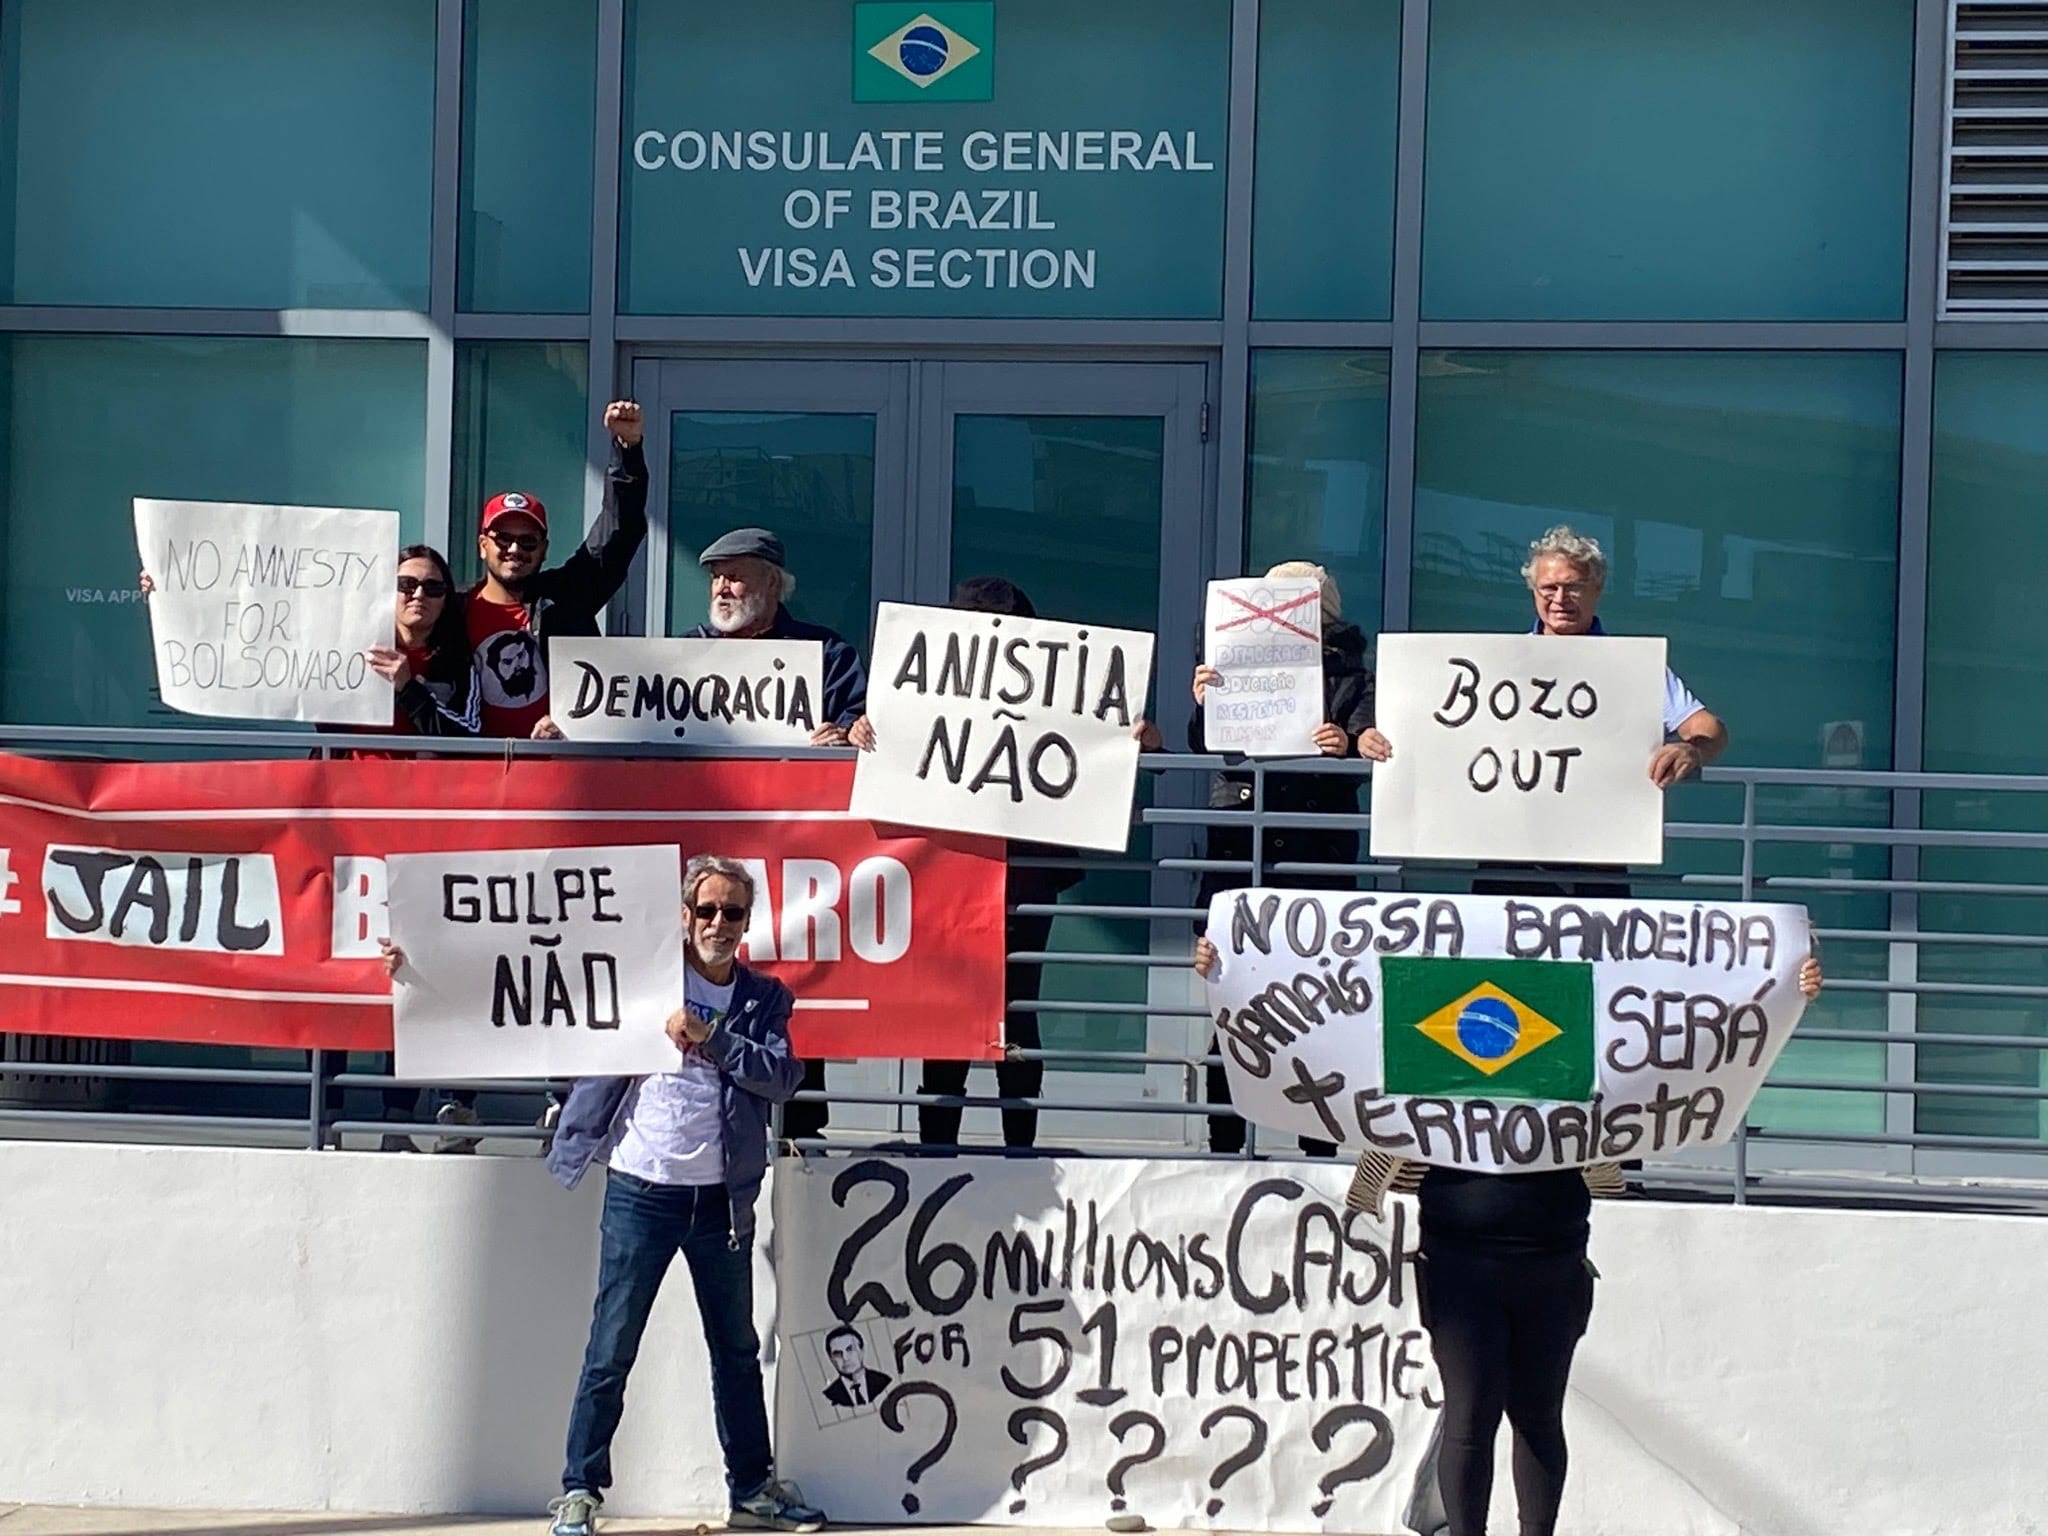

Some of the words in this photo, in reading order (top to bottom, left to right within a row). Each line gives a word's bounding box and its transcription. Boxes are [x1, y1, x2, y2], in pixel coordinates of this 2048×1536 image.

[633, 130, 945, 171] CONSULATE
[962, 130, 1214, 171] GENERAL
[784, 190, 852, 229] OF
[870, 190, 1055, 230] BRAZIL
[738, 248, 856, 288] VISA
[870, 248, 1096, 289] SECTION
[164, 538, 221, 593] NO
[229, 543, 379, 591] AMNESTY
[65, 588, 104, 603] VISA
[223, 600, 291, 645] FOR
[163, 639, 366, 691] BOLSONARO
[889, 617, 1131, 727] ANISTIA
[1433, 657, 1598, 728] BOZO
[915, 708, 1078, 803] NÃO
[1468, 747, 1582, 793] OUT
[443, 866, 623, 924] GOLPE
[1232, 892, 1464, 958] NOSSA
[1504, 899, 1776, 971] BANDEIRA
[491, 933, 620, 1030] NÃO
[1606, 978, 1776, 1073] SERÁ
[827, 1159, 977, 1323] 26
[894, 1322, 970, 1375] FOR
[1001, 1302, 1128, 1405] 51
